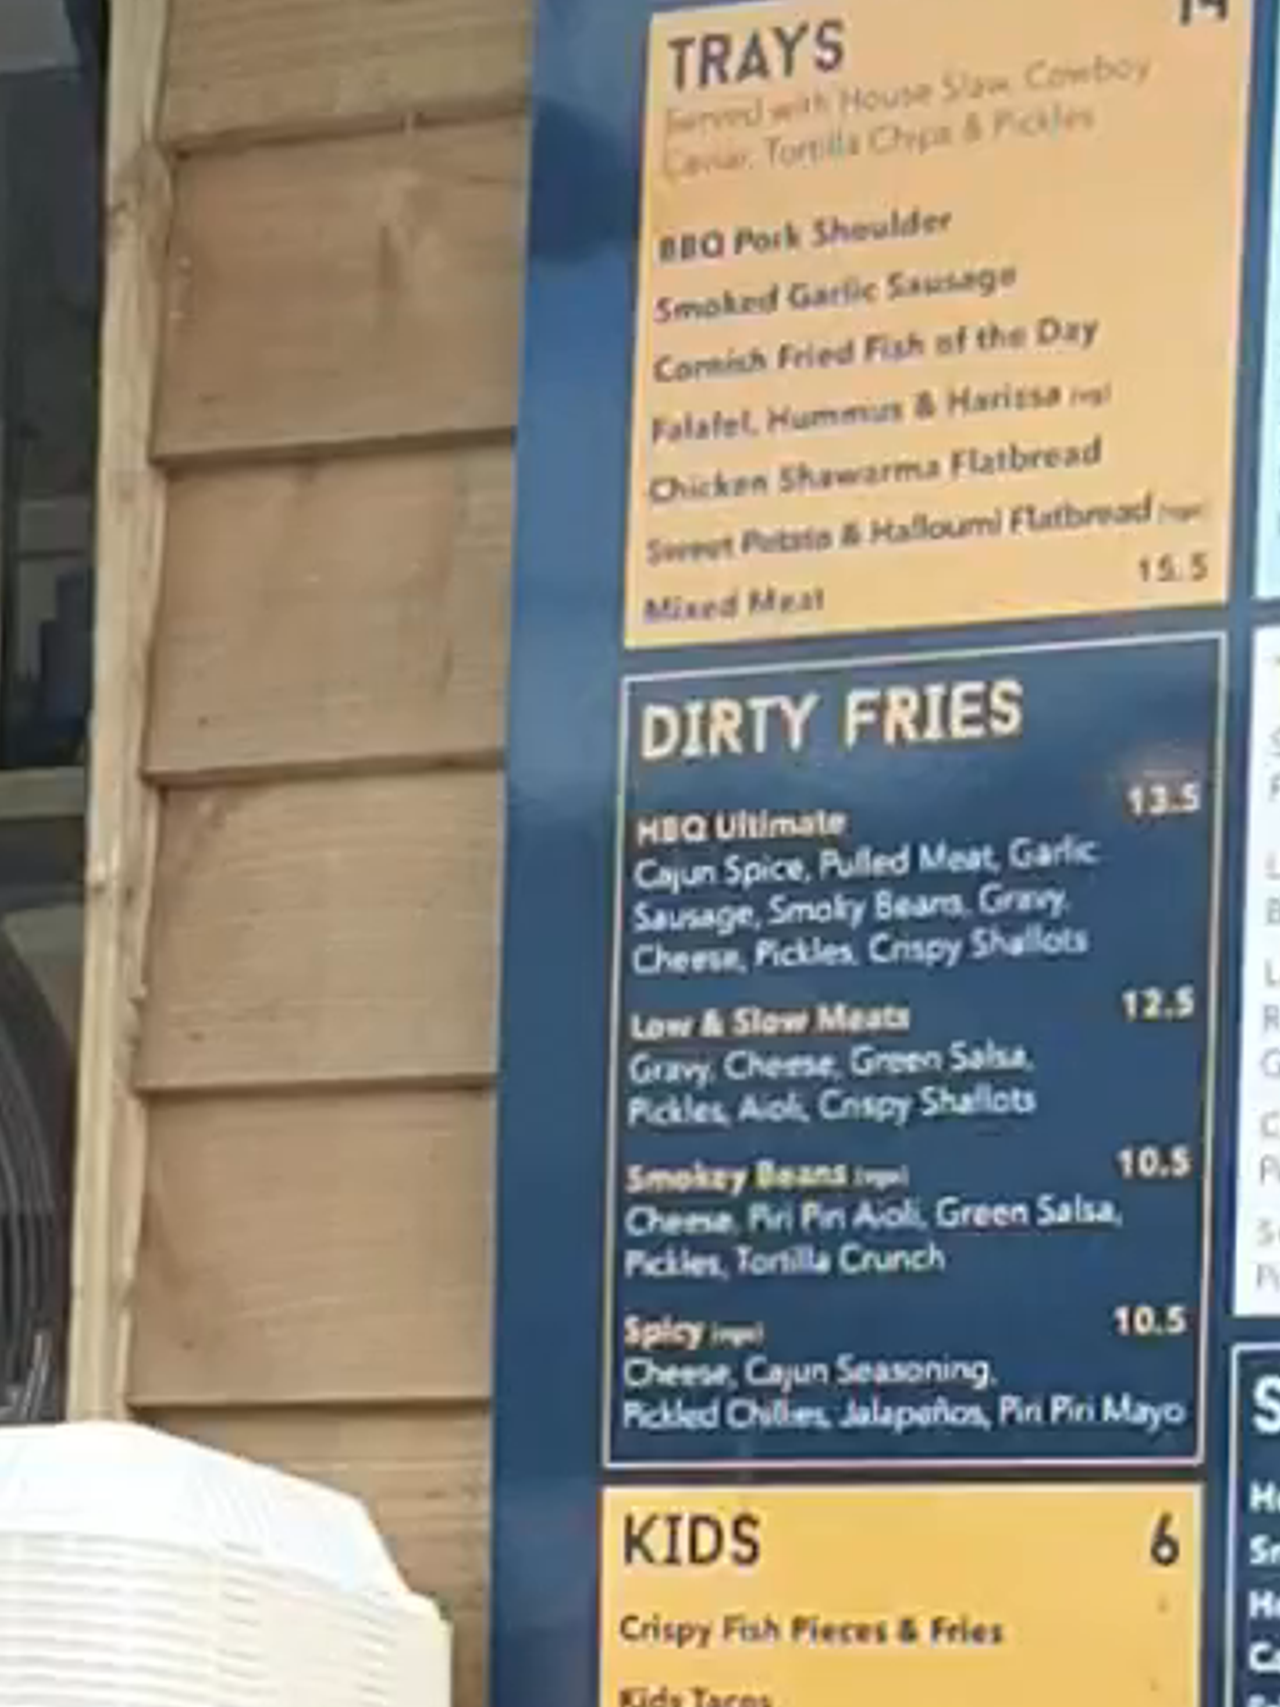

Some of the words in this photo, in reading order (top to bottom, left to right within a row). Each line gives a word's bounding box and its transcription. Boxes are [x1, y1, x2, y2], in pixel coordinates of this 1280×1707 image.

[667, 20, 845, 90] TRAYS
[839, 82, 931, 115] House
[1024, 55, 1150, 90] Cowboy
[734, 222, 799, 255] Pork
[813, 207, 952, 246] Shoulder
[655, 285, 778, 324] Smoked
[788, 276, 876, 310] Garlic
[887, 255, 1017, 301] Sausage
[654, 347, 768, 383] Cornish
[778, 341, 855, 369] Fried
[864, 332, 923, 362] Fish
[936, 327, 969, 354] of
[977, 323, 1022, 349] the
[1037, 316, 1100, 348] Day
[768, 400, 903, 433] Hummus
[916, 391, 935, 418] &
[948, 385, 1061, 415] Harissa
[650, 470, 768, 504] Chicken
[780, 455, 941, 491] Shawarma
[952, 436, 1101, 476] Flatbread
[647, 532, 733, 565] Sweet
[742, 524, 832, 554] Potato
[871, 508, 1002, 544] Halloumi
[1010, 494, 1152, 535] Flatbread
[1139, 552, 1208, 583] 15.5
[646, 592, 738, 623] Mixed
[749, 588, 825, 613] Meat
[641, 692, 819, 759] DIRTY
[846, 680, 1025, 747] FRIES
[715, 810, 847, 842] Ultimate
[634, 855, 717, 895] Cajun
[820, 845, 909, 881] Pulled
[1009, 835, 1099, 869] Garlic
[868, 933, 963, 969] Crispy
[972, 925, 1089, 959] Shallots
[631, 1012, 692, 1040] Low
[702, 1008, 722, 1036] &
[734, 1005, 808, 1036] Slow
[818, 1003, 910, 1033] Meats
[1123, 987, 1195, 1019] 12.5
[851, 1044, 942, 1076] Green
[817, 1089, 912, 1128] Crispy
[921, 1083, 1037, 1117] Shallots
[756, 1160, 848, 1188] Beans
[1118, 1147, 1192, 1178] 10.5
[936, 1195, 1028, 1227] Green
[737, 1245, 830, 1275] Tortilla
[839, 1244, 945, 1273] Crunch
[624, 1315, 707, 1351] Spicy
[1115, 1305, 1185, 1335] 10.5
[745, 1355, 828, 1391] Cajun
[622, 1402, 718, 1429] Pickled
[999, 1395, 1045, 1423] Piri
[1052, 1395, 1096, 1423] Piri
[1103, 1398, 1185, 1432] Mayo
[623, 1512, 762, 1567] KIDS
[1151, 1512, 1179, 1566] 6
[619, 1616, 712, 1647] Crispy
[723, 1617, 779, 1642] Fish
[791, 1618, 887, 1644] Pieces
[899, 1617, 918, 1643] &
[930, 1617, 1004, 1645] Fries
